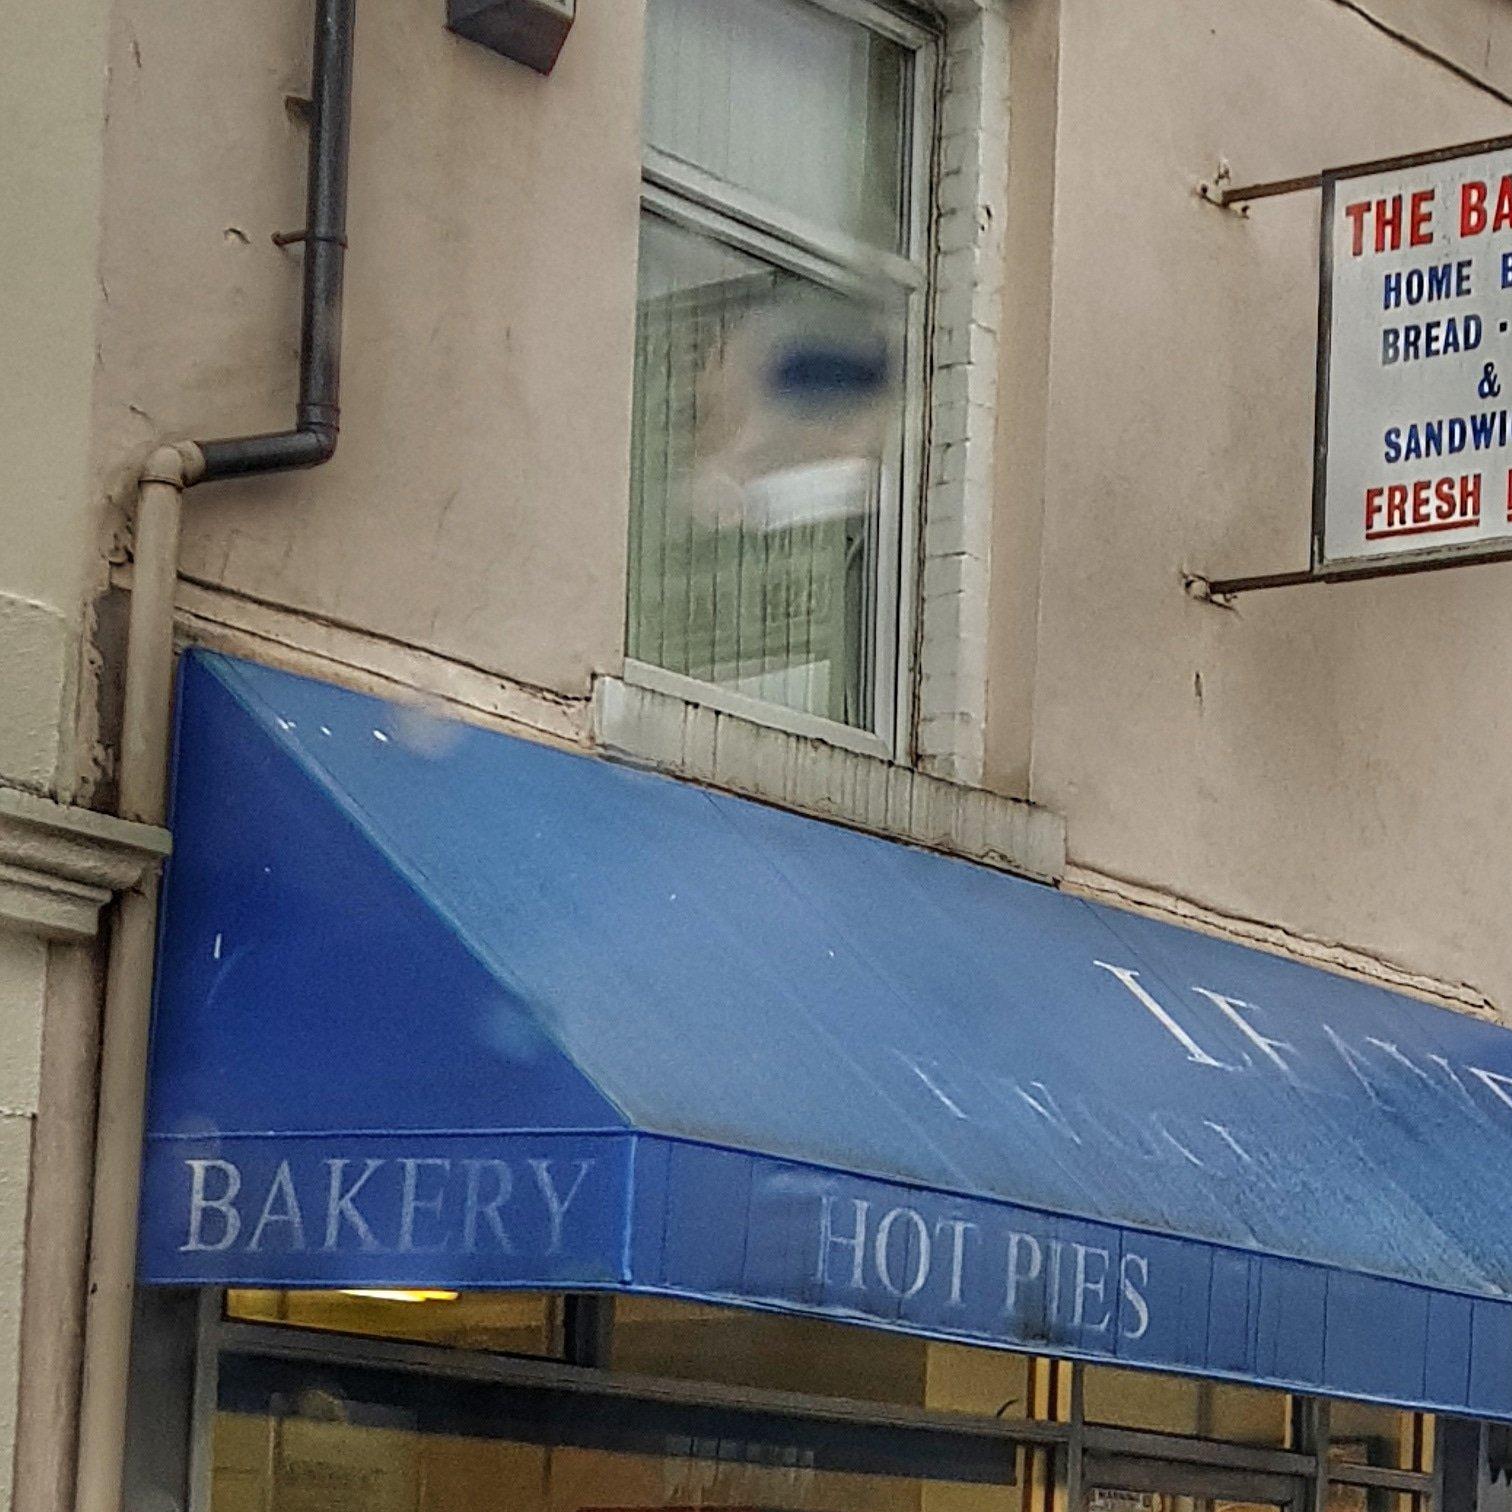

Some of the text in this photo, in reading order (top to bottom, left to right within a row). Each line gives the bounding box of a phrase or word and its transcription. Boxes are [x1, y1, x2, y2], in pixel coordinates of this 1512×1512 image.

[1346, 189, 1435, 258] THE
[1383, 259, 1473, 310] HOME
[1381, 313, 1482, 366] BREAD
[1477, 361, 1501, 399] &
[1365, 473, 1482, 529] FRESH
[180, 1156, 596, 1256] BAKERY
[819, 1193, 1152, 1342] HOT PIES
